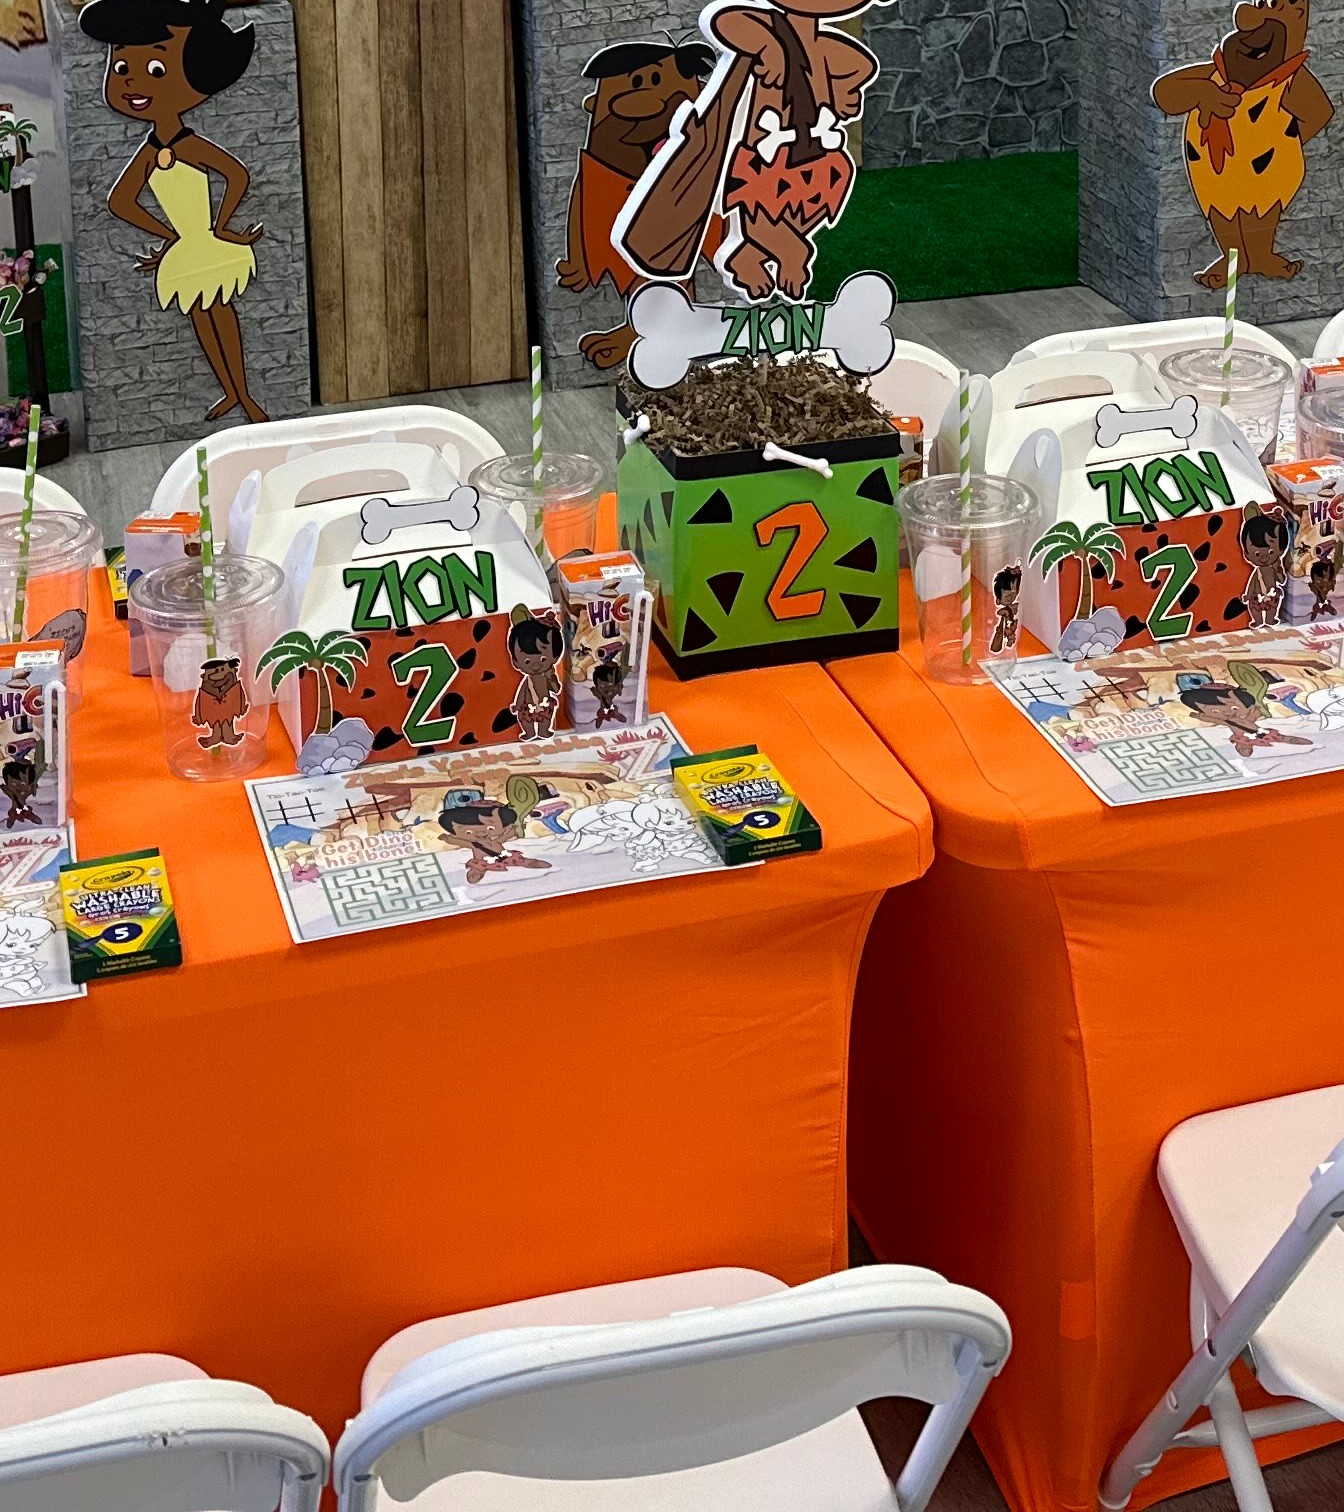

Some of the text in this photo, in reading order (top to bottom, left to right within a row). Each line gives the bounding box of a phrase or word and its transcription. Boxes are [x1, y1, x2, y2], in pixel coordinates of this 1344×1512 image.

[721, 301, 826, 358] ZION
[1086, 451, 1235, 526] ZION
[753, 500, 830, 622] 2
[343, 550, 498, 631] ZION
[1140, 544, 1198, 641] 2
[391, 642, 457, 747] 2
[1083, 710, 1166, 730] Get Dino
[754, 815, 769, 826] 5
[321, 831, 414, 858] Get Dino
[325, 838, 423, 868] his bone!
[71, 888, 162, 910] WASHABLE
[115, 927, 129, 940] 5
